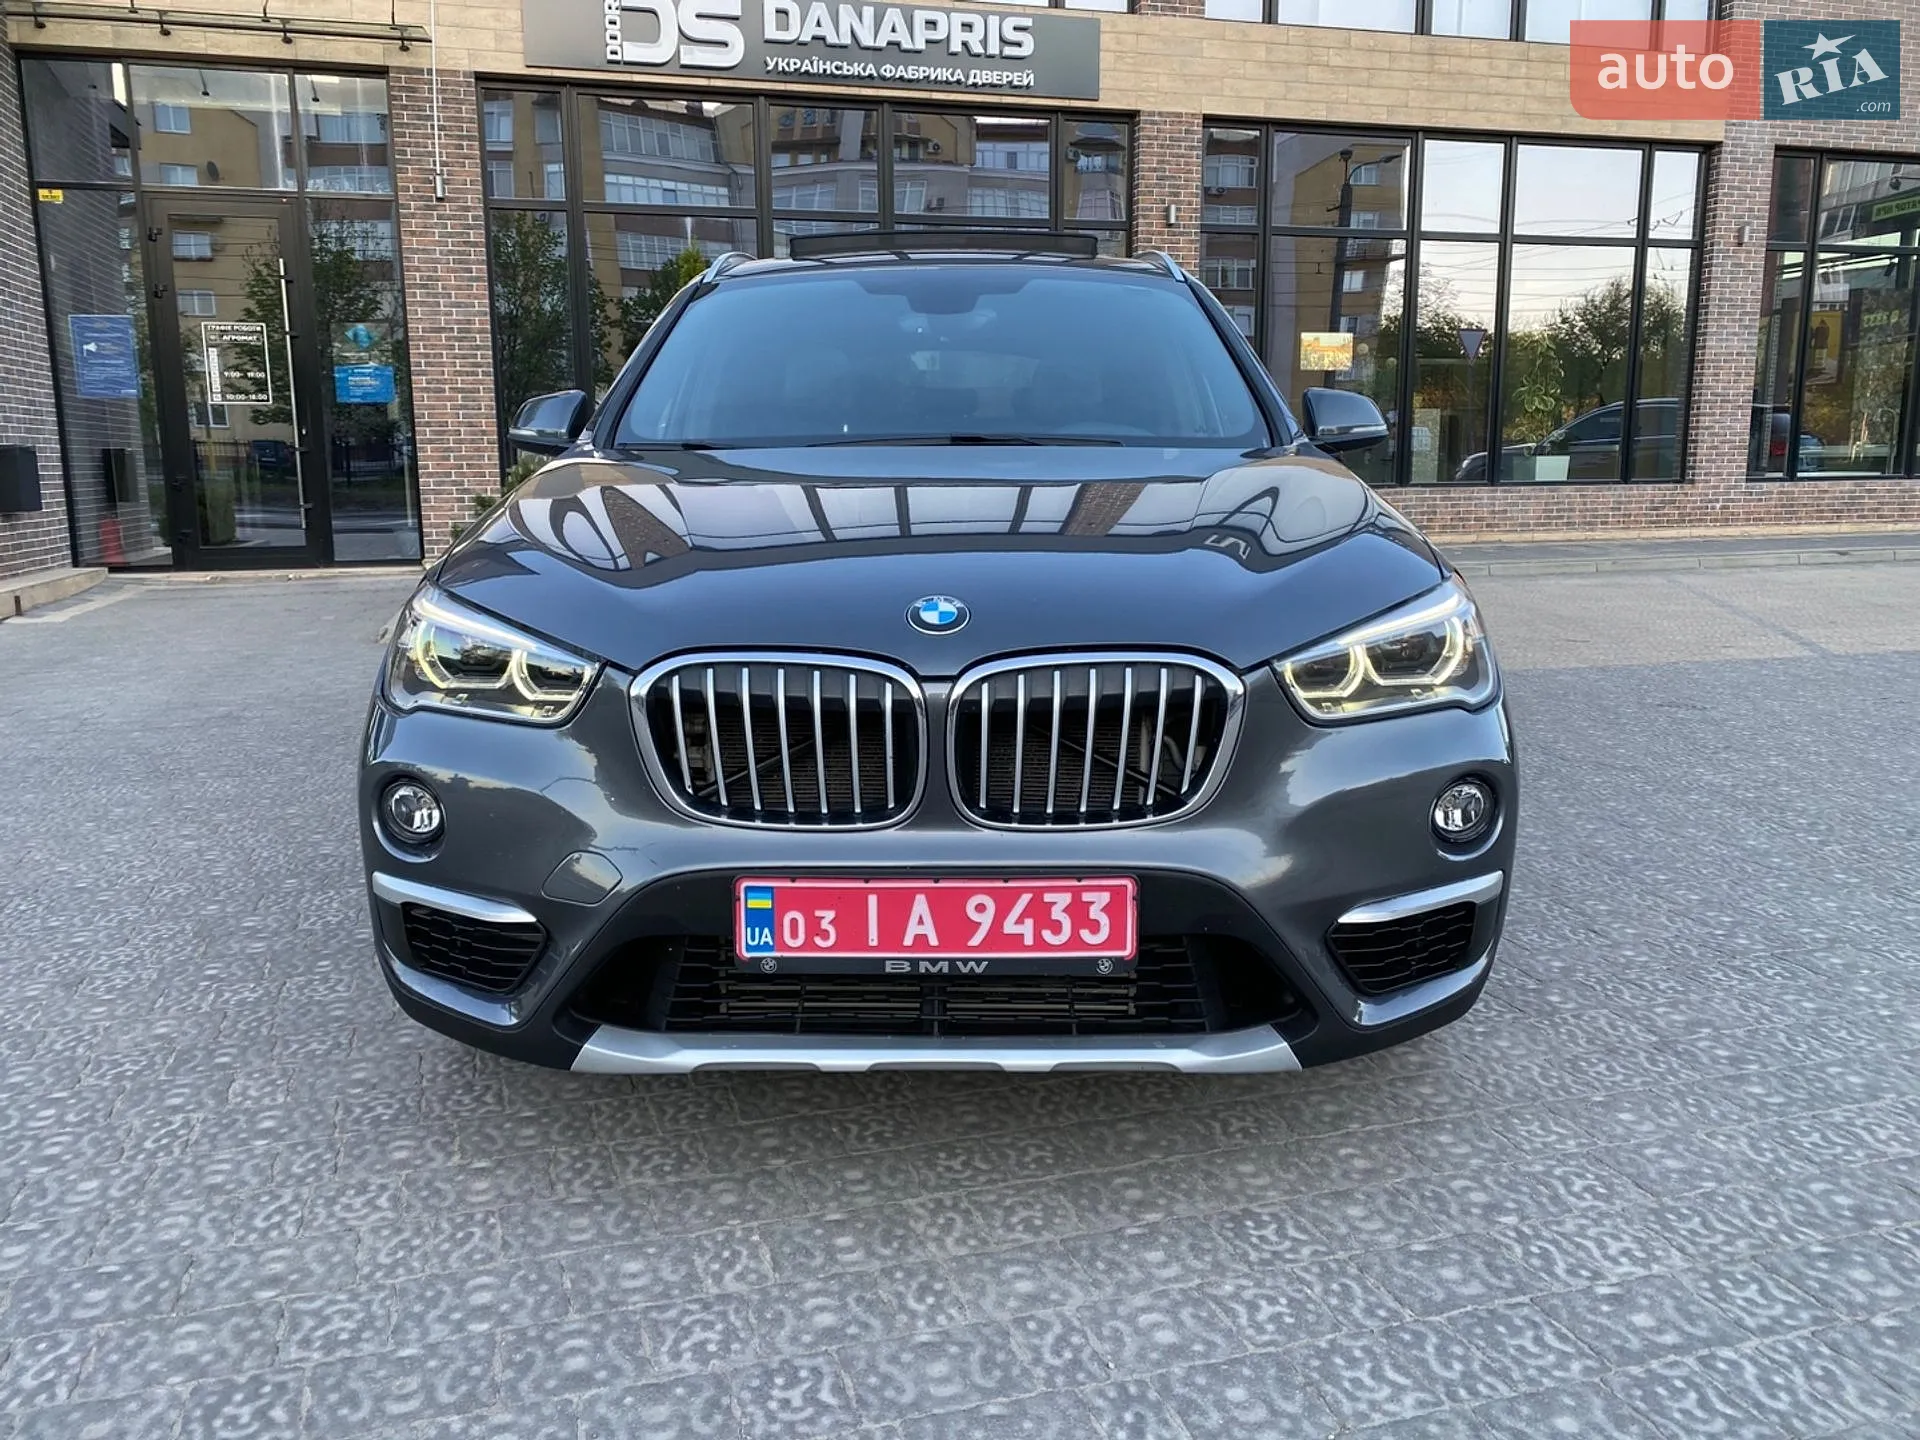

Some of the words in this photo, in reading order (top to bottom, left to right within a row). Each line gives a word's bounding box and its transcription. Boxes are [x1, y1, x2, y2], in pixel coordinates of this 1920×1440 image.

[763, 0, 1035, 58] DANAPRIS
[765, 56, 877, 78] УКРАЇНСЬКА
[879, 63, 965, 83] ФАБРИКА
[966, 69, 1035, 87] ДВЕРЕЙ
[782, 909, 837, 948] 03
[965, 891, 1111, 947] 9433
[746, 926, 774, 946] UA
[884, 959, 989, 974] BMW
